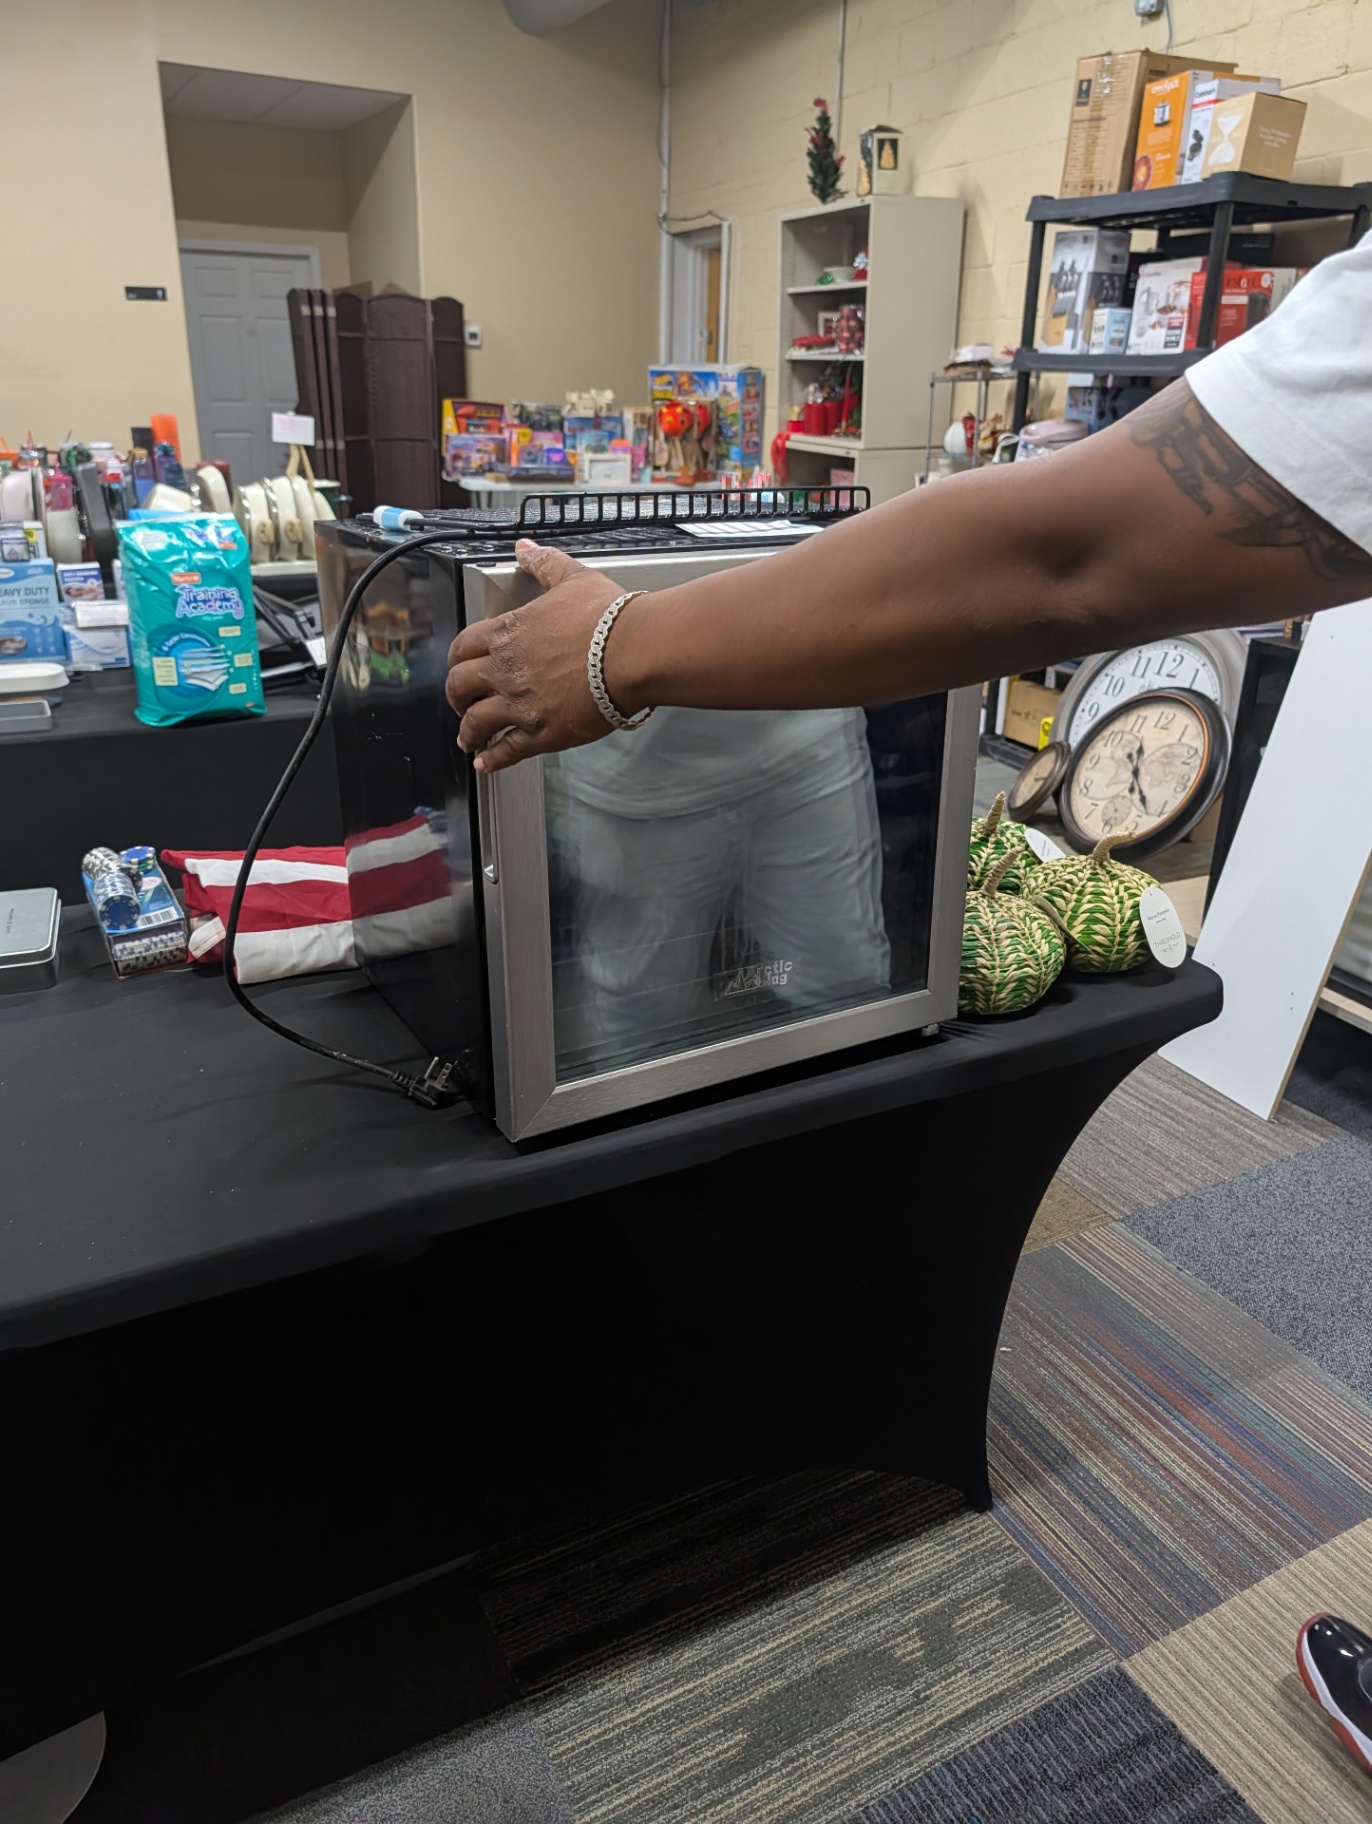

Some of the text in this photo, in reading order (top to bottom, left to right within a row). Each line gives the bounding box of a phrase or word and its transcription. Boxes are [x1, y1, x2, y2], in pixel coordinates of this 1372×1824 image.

[24, 586, 50, 597] DUTY
[175, 584, 239, 602] Training
[20, 597, 50, 606] SPONGE
[176, 600, 244, 619] Academy
[1130, 655, 1152, 679] 11
[1154, 652, 1184, 678] 12
[1103, 673, 1125, 698] 10
[1188, 667, 1200, 689] 1
[1085, 701, 1101, 724] 9
[1154, 711, 1176, 730] 12
[1130, 713, 1148, 734] 11
[1178, 723, 1189, 743] 1
[1103, 730, 1125, 748] 10
[1085, 753, 1100, 771] 9
[1181, 747, 1198, 766] 2
[1079, 778, 1093, 796] 8
[1083, 801, 1099, 820] 7
[1154, 932, 1180, 947] THRESHOLD
